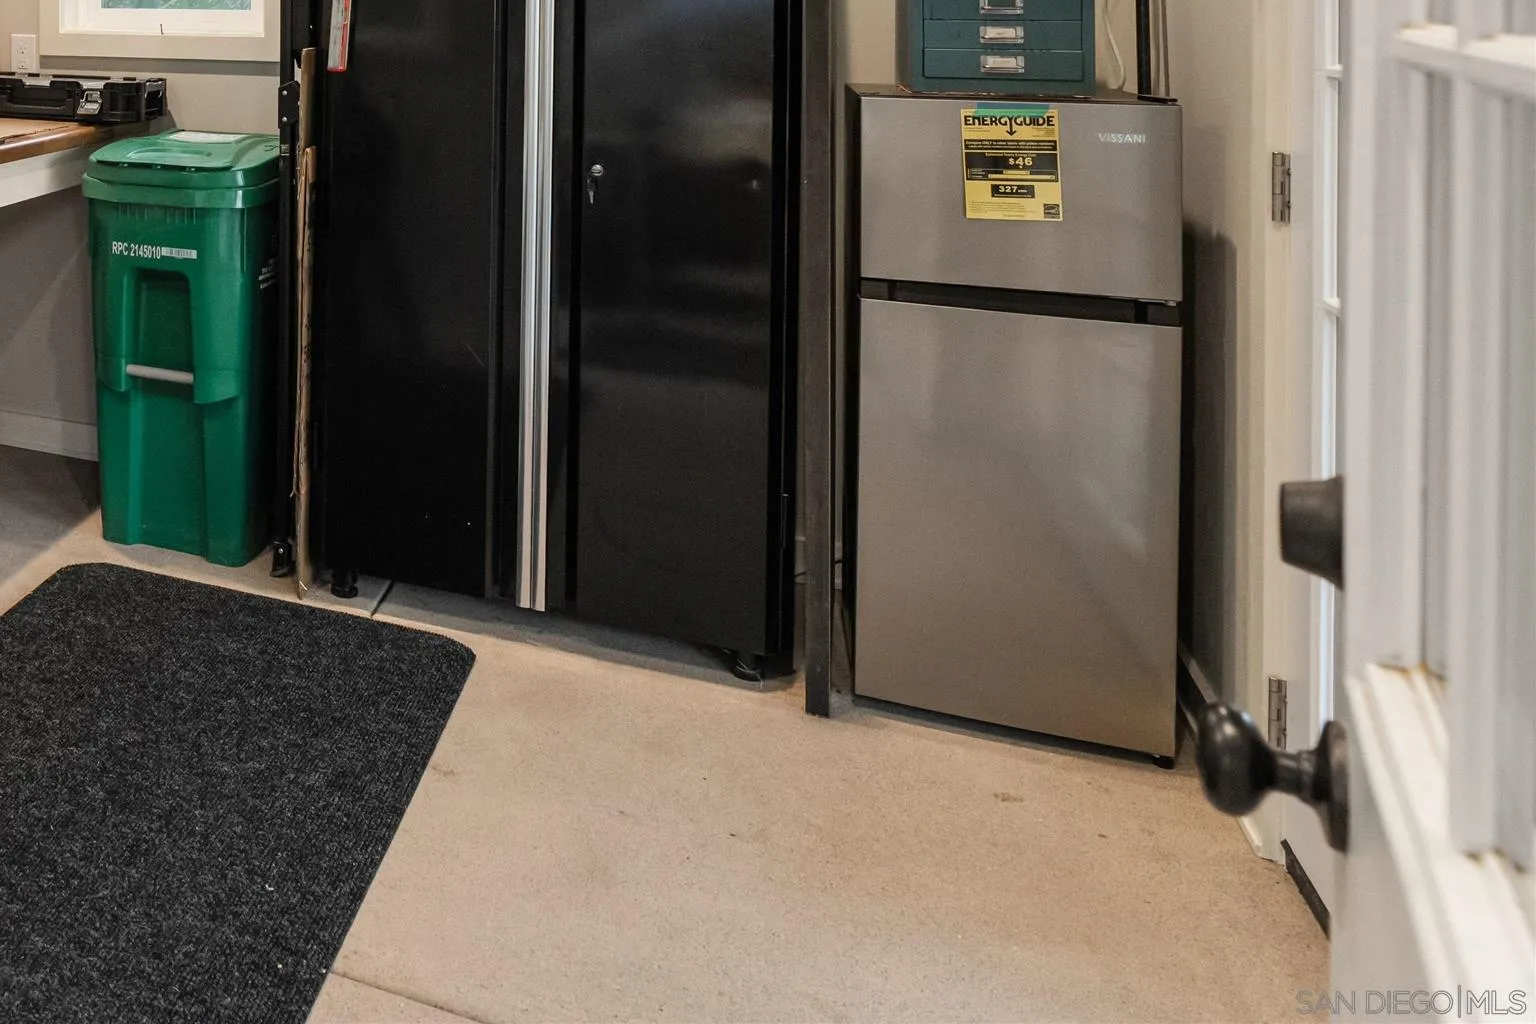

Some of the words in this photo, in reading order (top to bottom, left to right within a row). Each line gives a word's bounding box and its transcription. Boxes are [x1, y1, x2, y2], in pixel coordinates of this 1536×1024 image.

[1097, 133, 1146, 143] VISSANI
[1008, 157, 1033, 166] $46
[998, 185, 1018, 193] 327
[112, 241, 129, 255] RPC
[130, 243, 161, 259] 2145010
